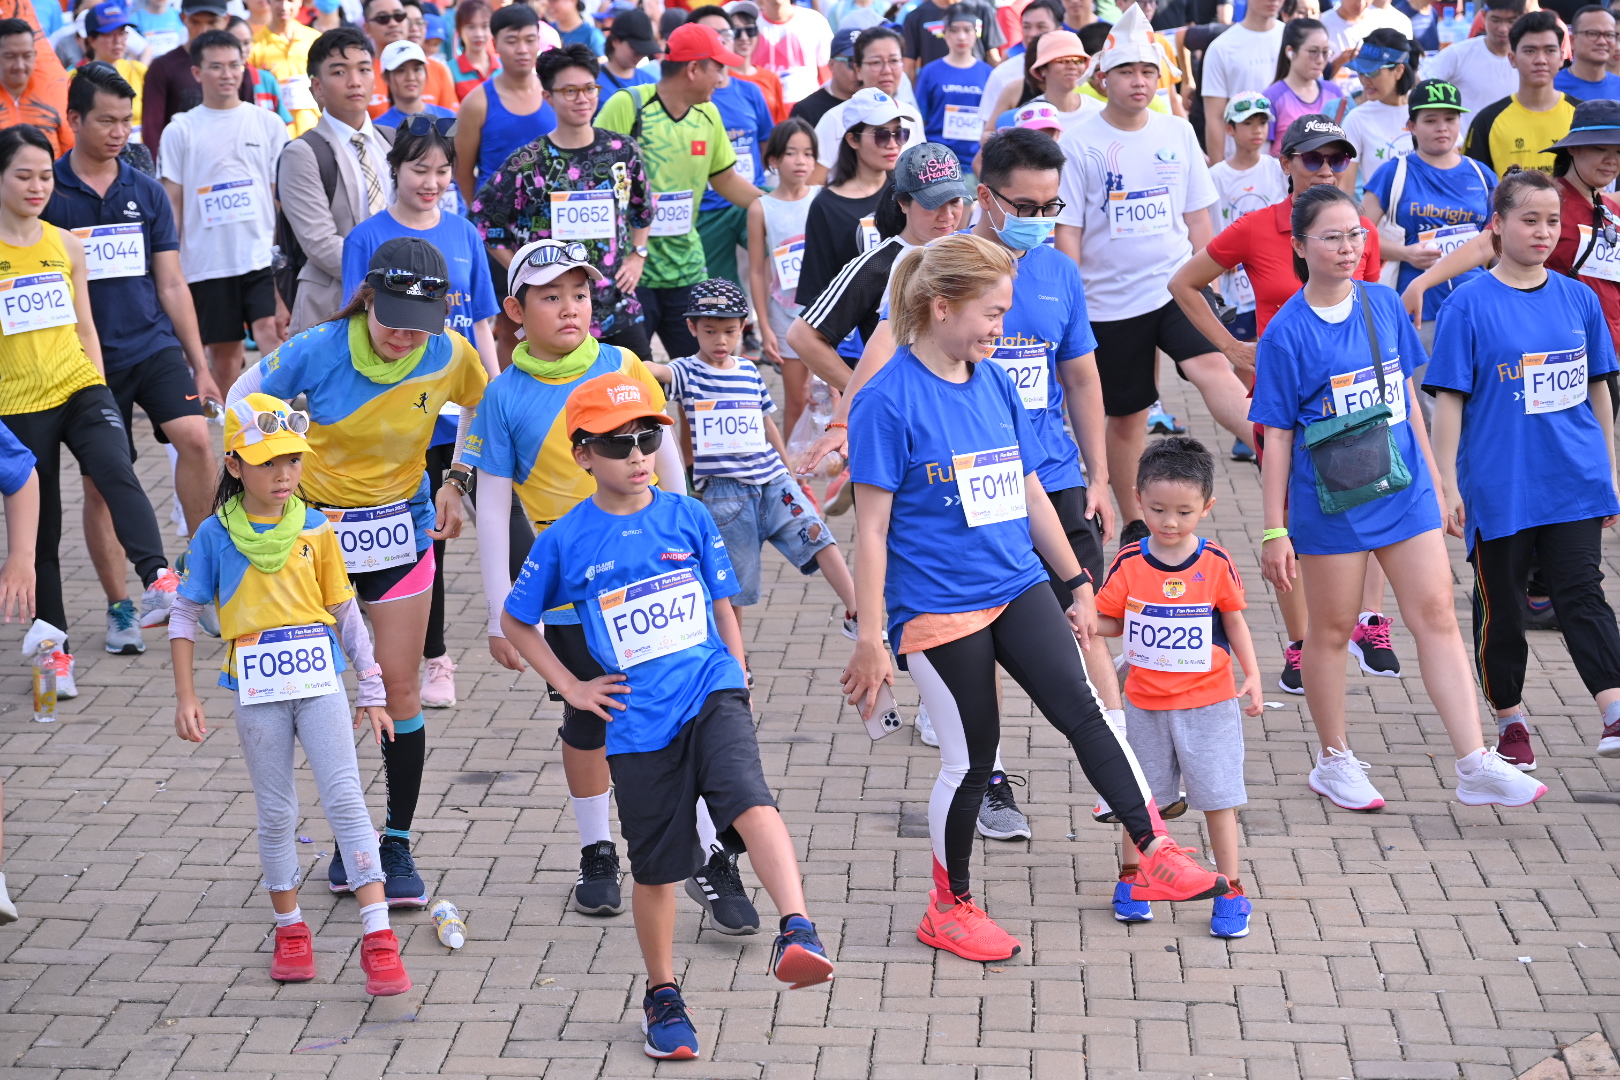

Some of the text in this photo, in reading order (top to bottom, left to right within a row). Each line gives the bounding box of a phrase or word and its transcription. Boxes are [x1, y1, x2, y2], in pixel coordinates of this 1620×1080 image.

[1425, 82, 1457, 103] NY
[204, 192, 250, 213] F1025
[557, 206, 609, 223] F0652
[1115, 201, 1166, 222] F1004
[1410, 201, 1475, 225] Fulbright
[4, 289, 65, 316] F0912
[1533, 365, 1585, 393] F1028
[617, 391, 640, 402] RUN
[1345, 381, 1400, 413] F0231
[703, 416, 758, 436] F1054
[970, 471, 1019, 502] F0111
[334, 523, 409, 552] 0900
[595, 560, 614, 570] PLANET
[595, 566, 614, 574] SPORTS
[613, 592, 696, 642] F0847
[1129, 620, 1203, 650] F0228
[244, 646, 327, 680] F0888
